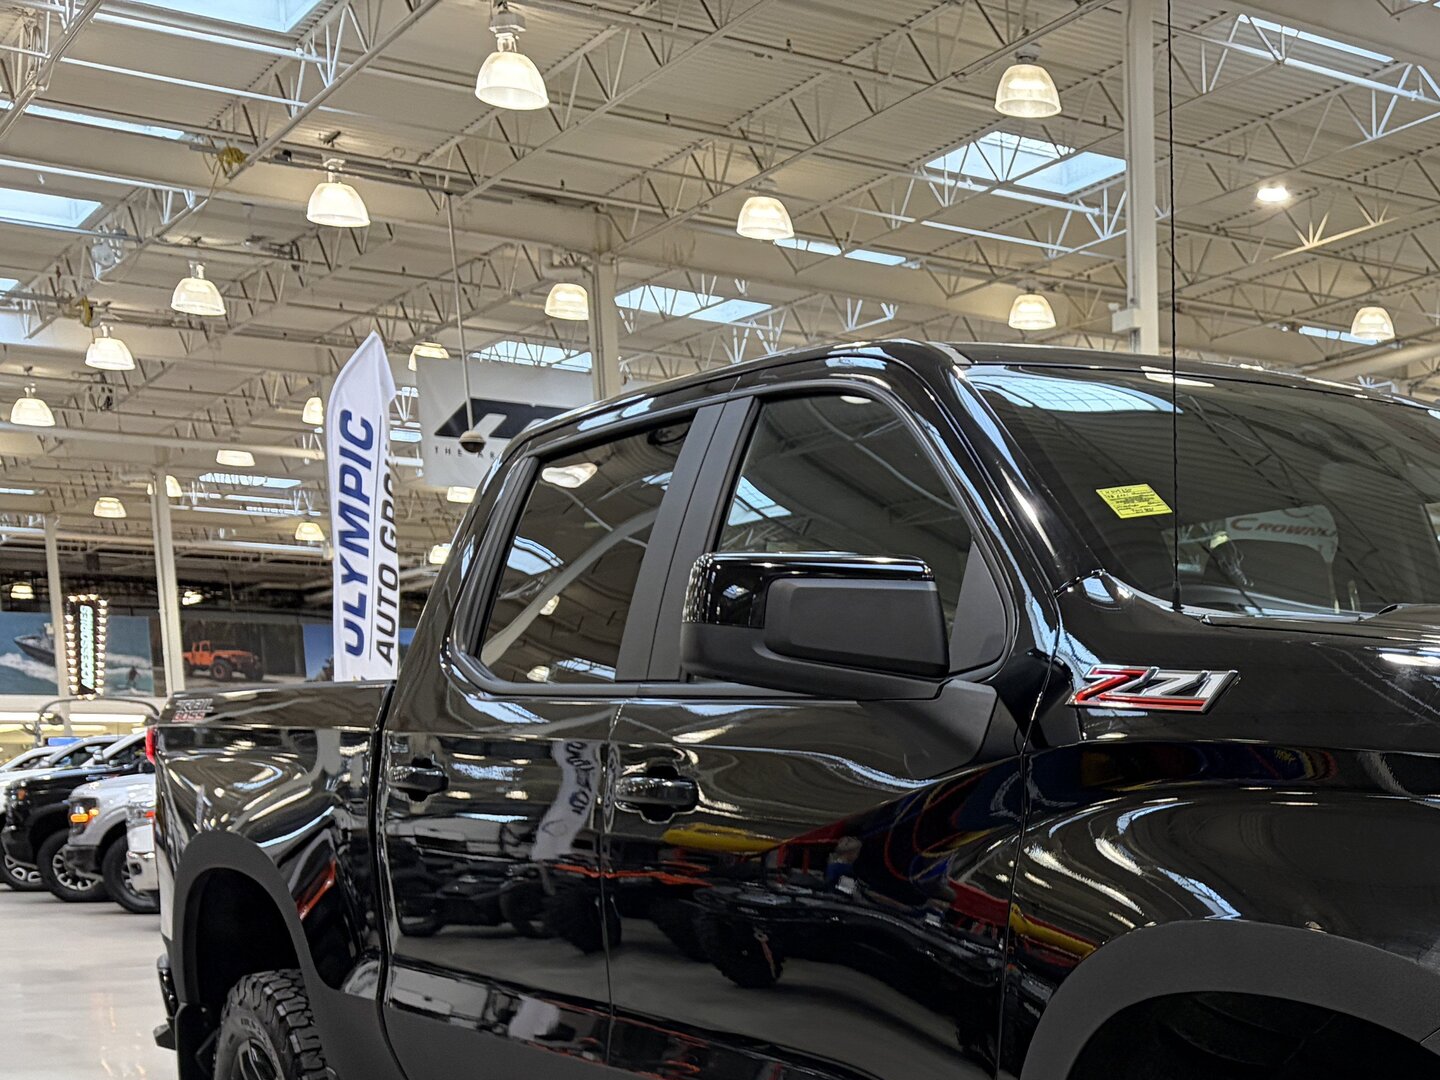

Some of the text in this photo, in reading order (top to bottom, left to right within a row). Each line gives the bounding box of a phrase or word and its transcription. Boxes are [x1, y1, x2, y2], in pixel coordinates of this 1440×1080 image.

[434, 445, 462, 457] THE
[339, 409, 374, 656] OLYMPIC
[79, 604, 95, 690] ACCESSORIES
[374, 562, 399, 667] AUTO
[1065, 664, 1242, 714] Z71
